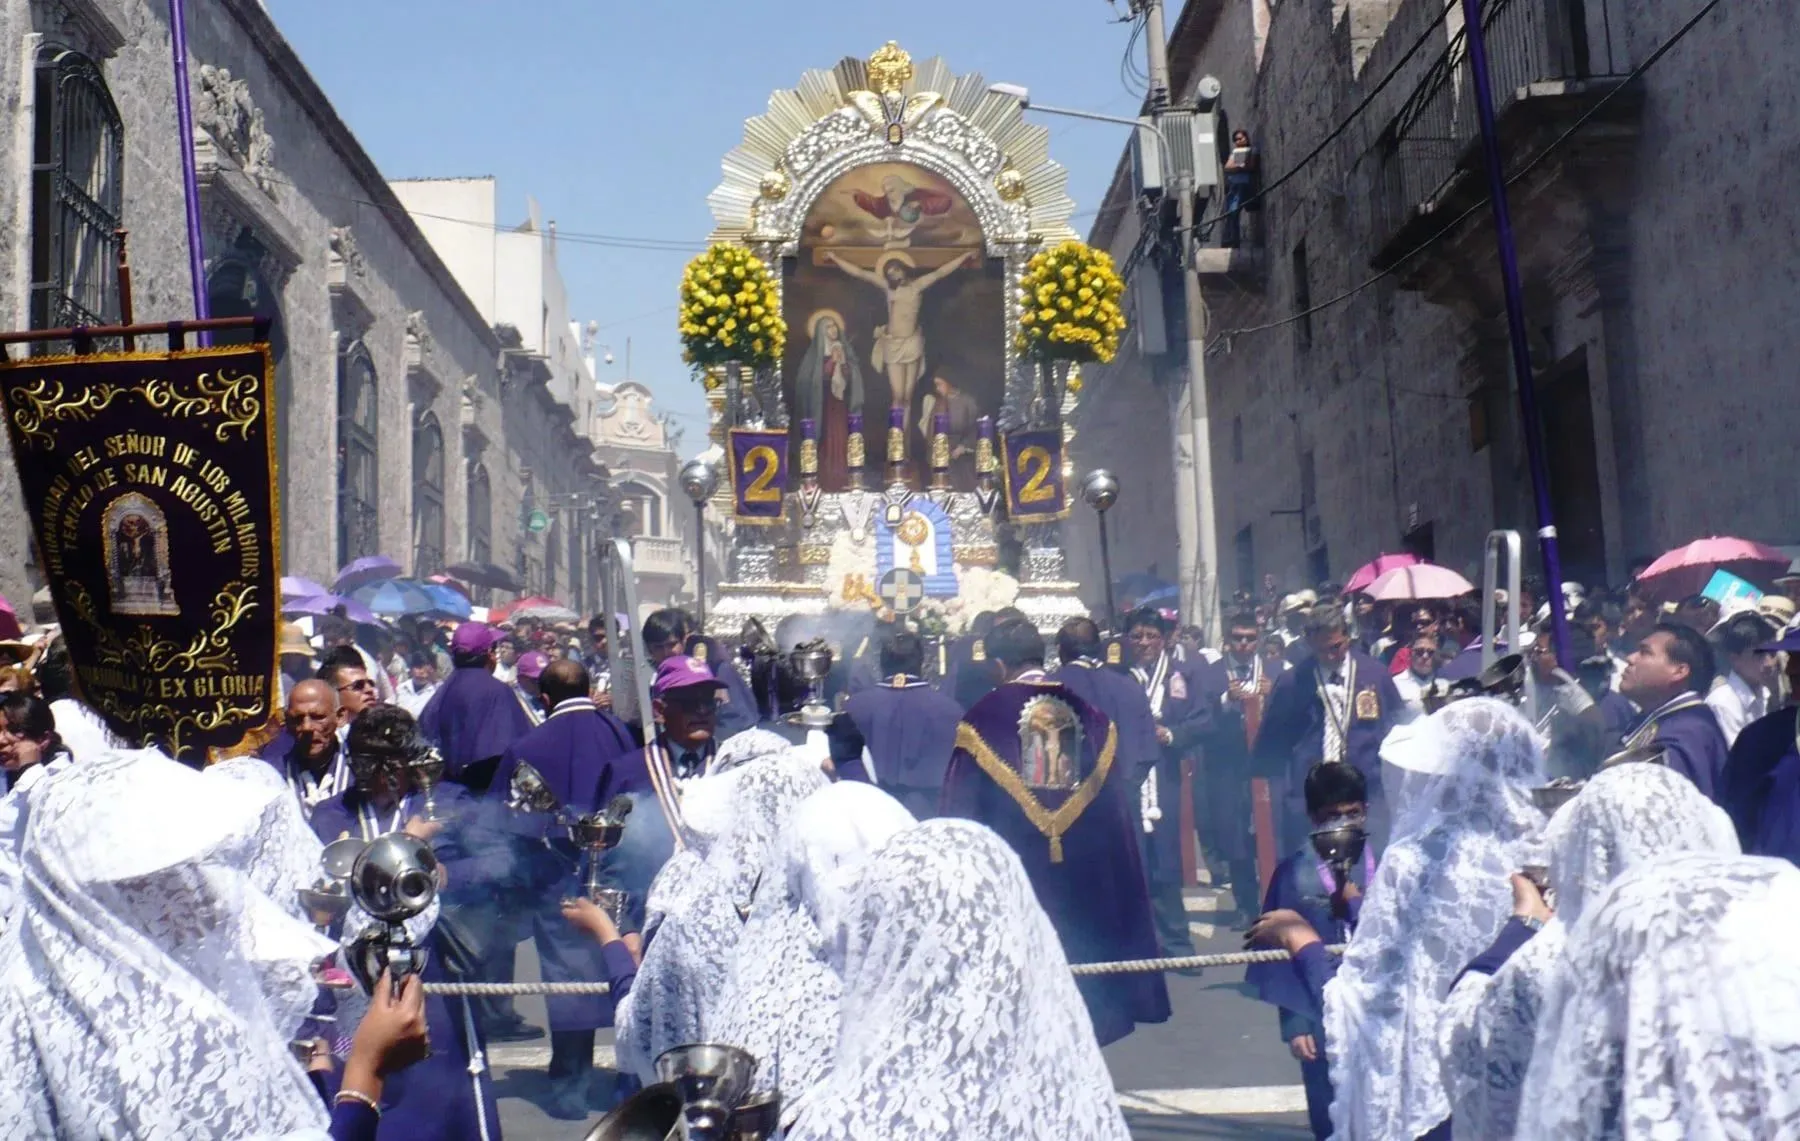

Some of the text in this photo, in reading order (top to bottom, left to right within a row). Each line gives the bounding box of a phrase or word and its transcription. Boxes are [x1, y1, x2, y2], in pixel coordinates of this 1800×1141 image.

[743, 445, 781, 502] 2
[1016, 446, 1055, 503] 2
[63, 463, 232, 554] TEMPLO DE SAN AGUSTIN
[67, 446, 102, 477] DEL
[104, 428, 166, 459] SEÑOR
[172, 442, 200, 469] DE
[199, 459, 231, 493] LOS
[223, 490, 260, 577] MILAGROS
[160, 678, 188, 698] EX
[194, 674, 265, 697] GLORIA
